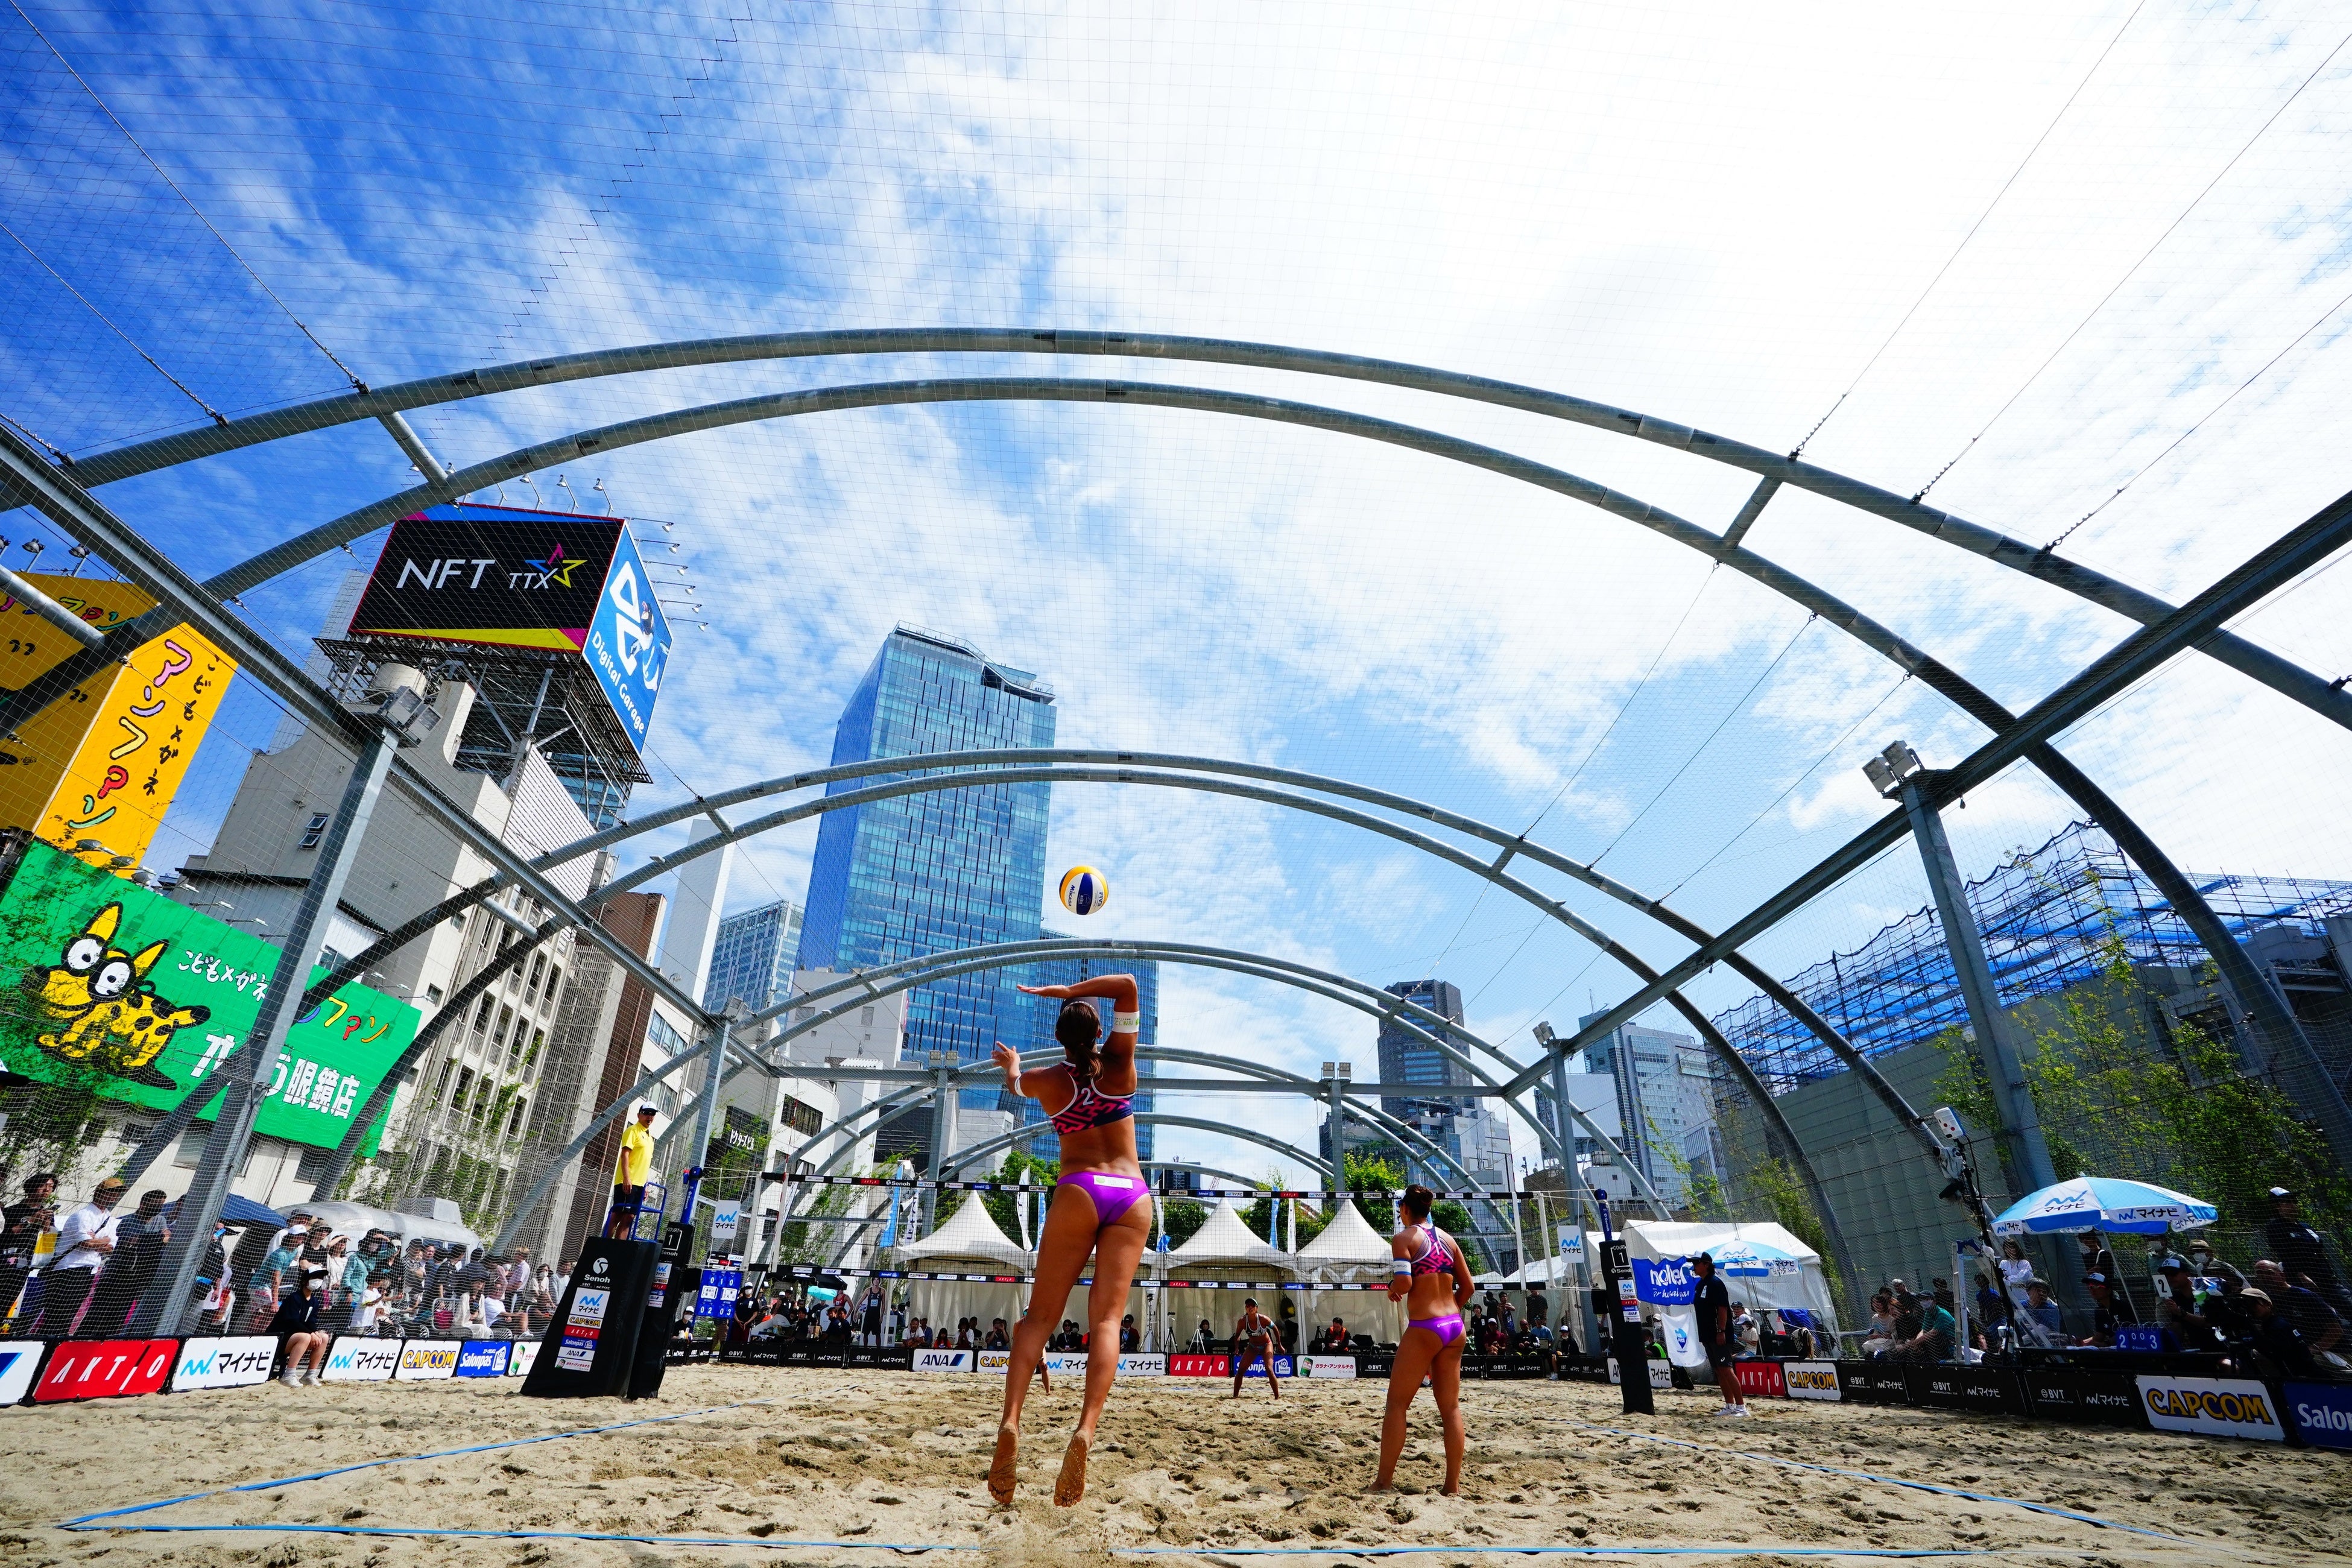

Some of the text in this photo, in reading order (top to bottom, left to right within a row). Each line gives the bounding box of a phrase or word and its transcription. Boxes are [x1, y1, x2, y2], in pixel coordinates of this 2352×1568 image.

[396, 558, 558, 590] NFT TTX
[592, 630, 645, 735] Digital Garage
[68, 639, 192, 829] アンファン
[178, 950, 269, 1002] こどもメガネ
[1081, 1087, 1094, 1106] 2
[2044, 1202, 2084, 1213] マイナビ
[2139, 1208, 2180, 1218] マイナビ
[668, 1236, 673, 1245] 1
[1433, 1242, 1440, 1256] 1
[1619, 1252, 1624, 1263] 1
[584, 1274, 610, 1283] Senoh
[2158, 1279, 2167, 1293] 2
[578, 1306, 599, 1315] マイナビ
[569, 1317, 601, 1327] CAPCOM
[2119, 1334, 2126, 1348] 2
[2149, 1335, 2157, 1349] 3
[51, 1344, 165, 1391] AKTIO
[218, 1351, 271, 1374] マイナビ
[357, 1351, 396, 1370] マイナビ
[402, 1350, 457, 1369] CAPCOM
[460, 1352, 493, 1370] Salonpas
[920, 1354, 949, 1366] ANA
[1064, 1359, 1087, 1370] マイナ
[1128, 1359, 1163, 1370] マイナビ
[1174, 1357, 1225, 1376] AKTIO
[1650, 1368, 1669, 1381] マイナビ
[1742, 1366, 1780, 1394] AKTIO
[1788, 1370, 1838, 1391] CAPCOM
[1854, 1376, 1903, 1390] BVT マイナビ
[1939, 1382, 2001, 1398] BVT マイナビ
[2048, 1389, 2129, 1406] BVT マイナビ
[2146, 1388, 2275, 1426] CAPCOM
